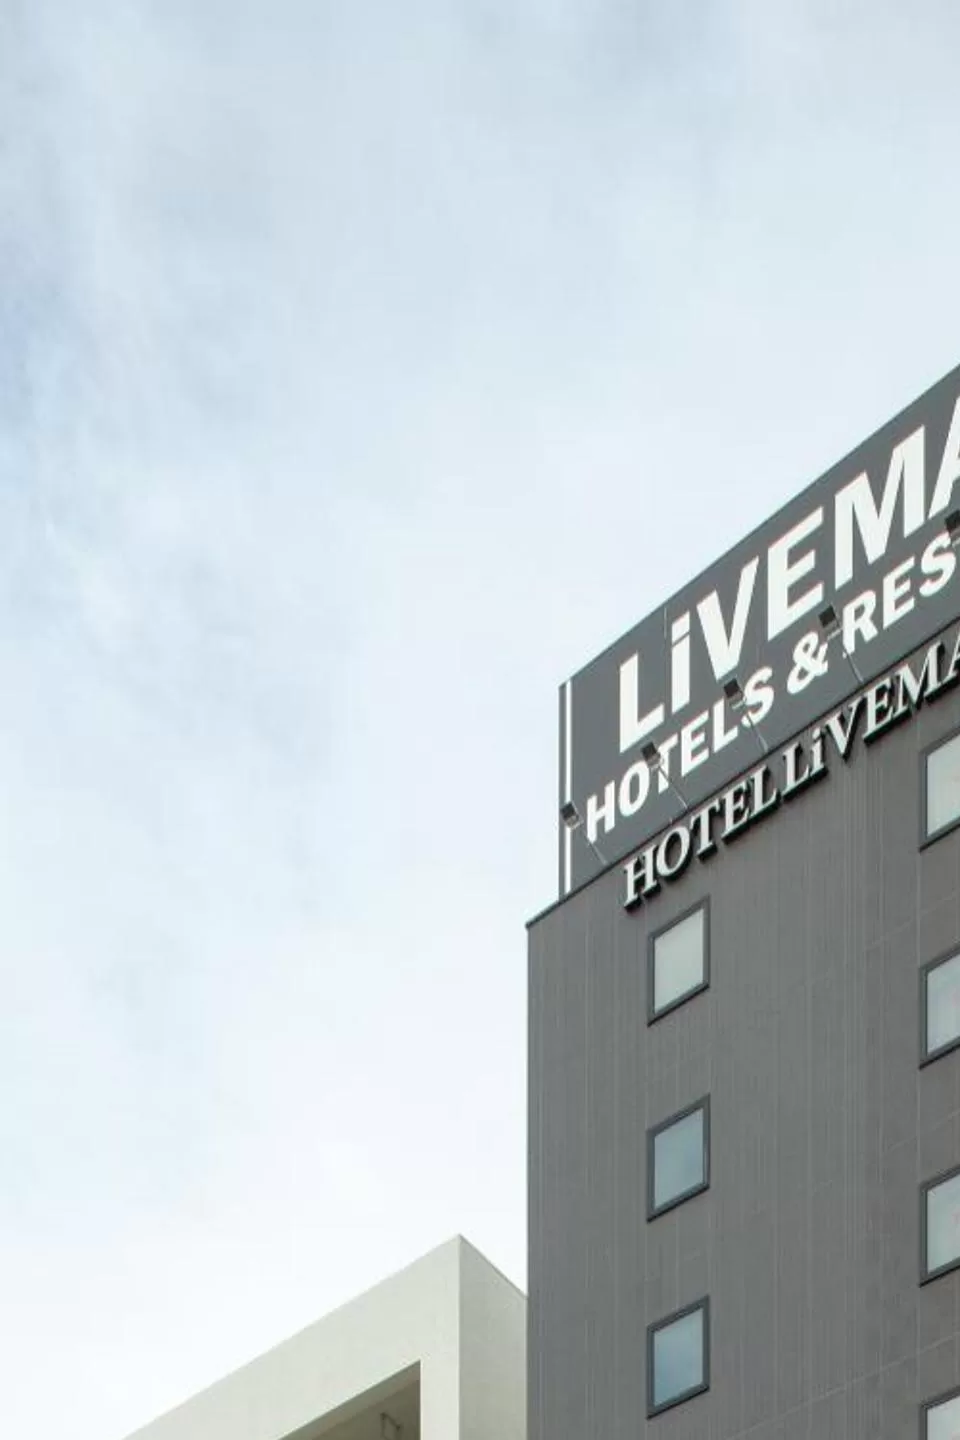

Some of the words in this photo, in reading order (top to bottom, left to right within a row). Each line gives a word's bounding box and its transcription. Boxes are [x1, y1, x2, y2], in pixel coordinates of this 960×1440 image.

[586, 666, 775, 843] HOTELS
[786, 630, 829, 694] &
[623, 765, 780, 909] HOTEL
